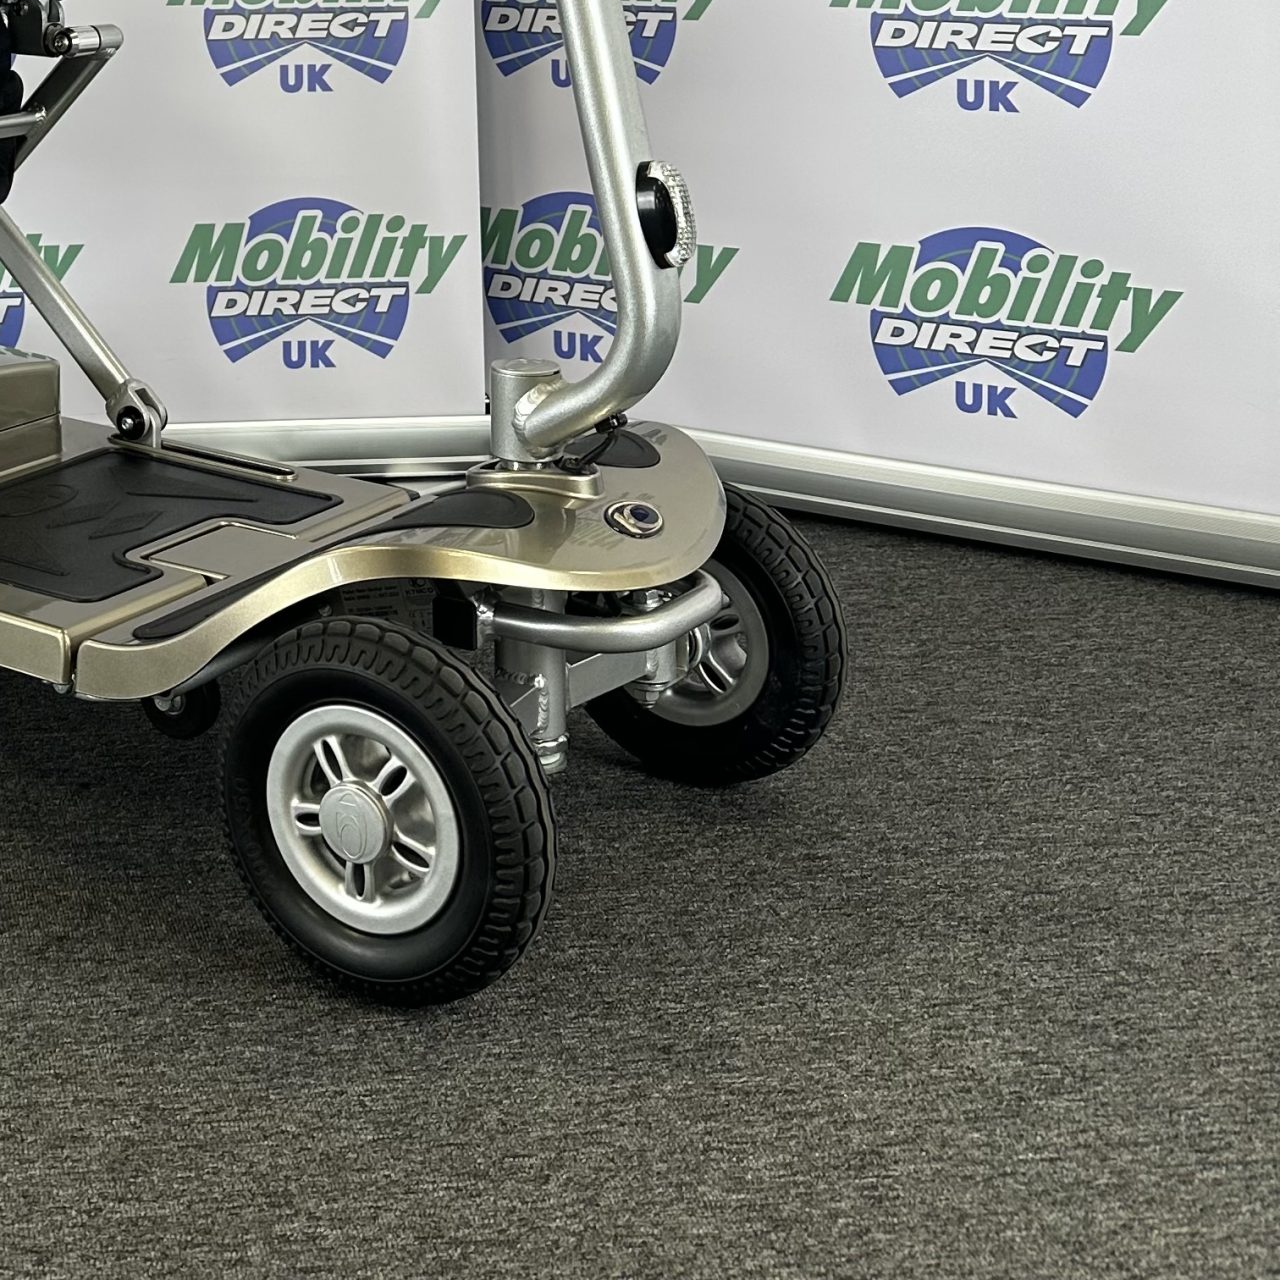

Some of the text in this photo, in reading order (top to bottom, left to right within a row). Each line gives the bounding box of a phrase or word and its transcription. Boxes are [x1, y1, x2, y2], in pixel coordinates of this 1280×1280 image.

[207, 12, 405, 40] DIRECT
[874, 20, 1109, 55] DIRECT
[279, 64, 334, 93] UK
[956, 79, 1020, 113] UK
[170, 214, 467, 294] Mobility
[210, 287, 406, 317] DIRECT
[829, 242, 1184, 353] Mobility
[282, 339, 336, 369] UK
[553, 330, 604, 363] UK
[874, 318, 1104, 367] DIRECT
[955, 381, 1018, 419] UK
